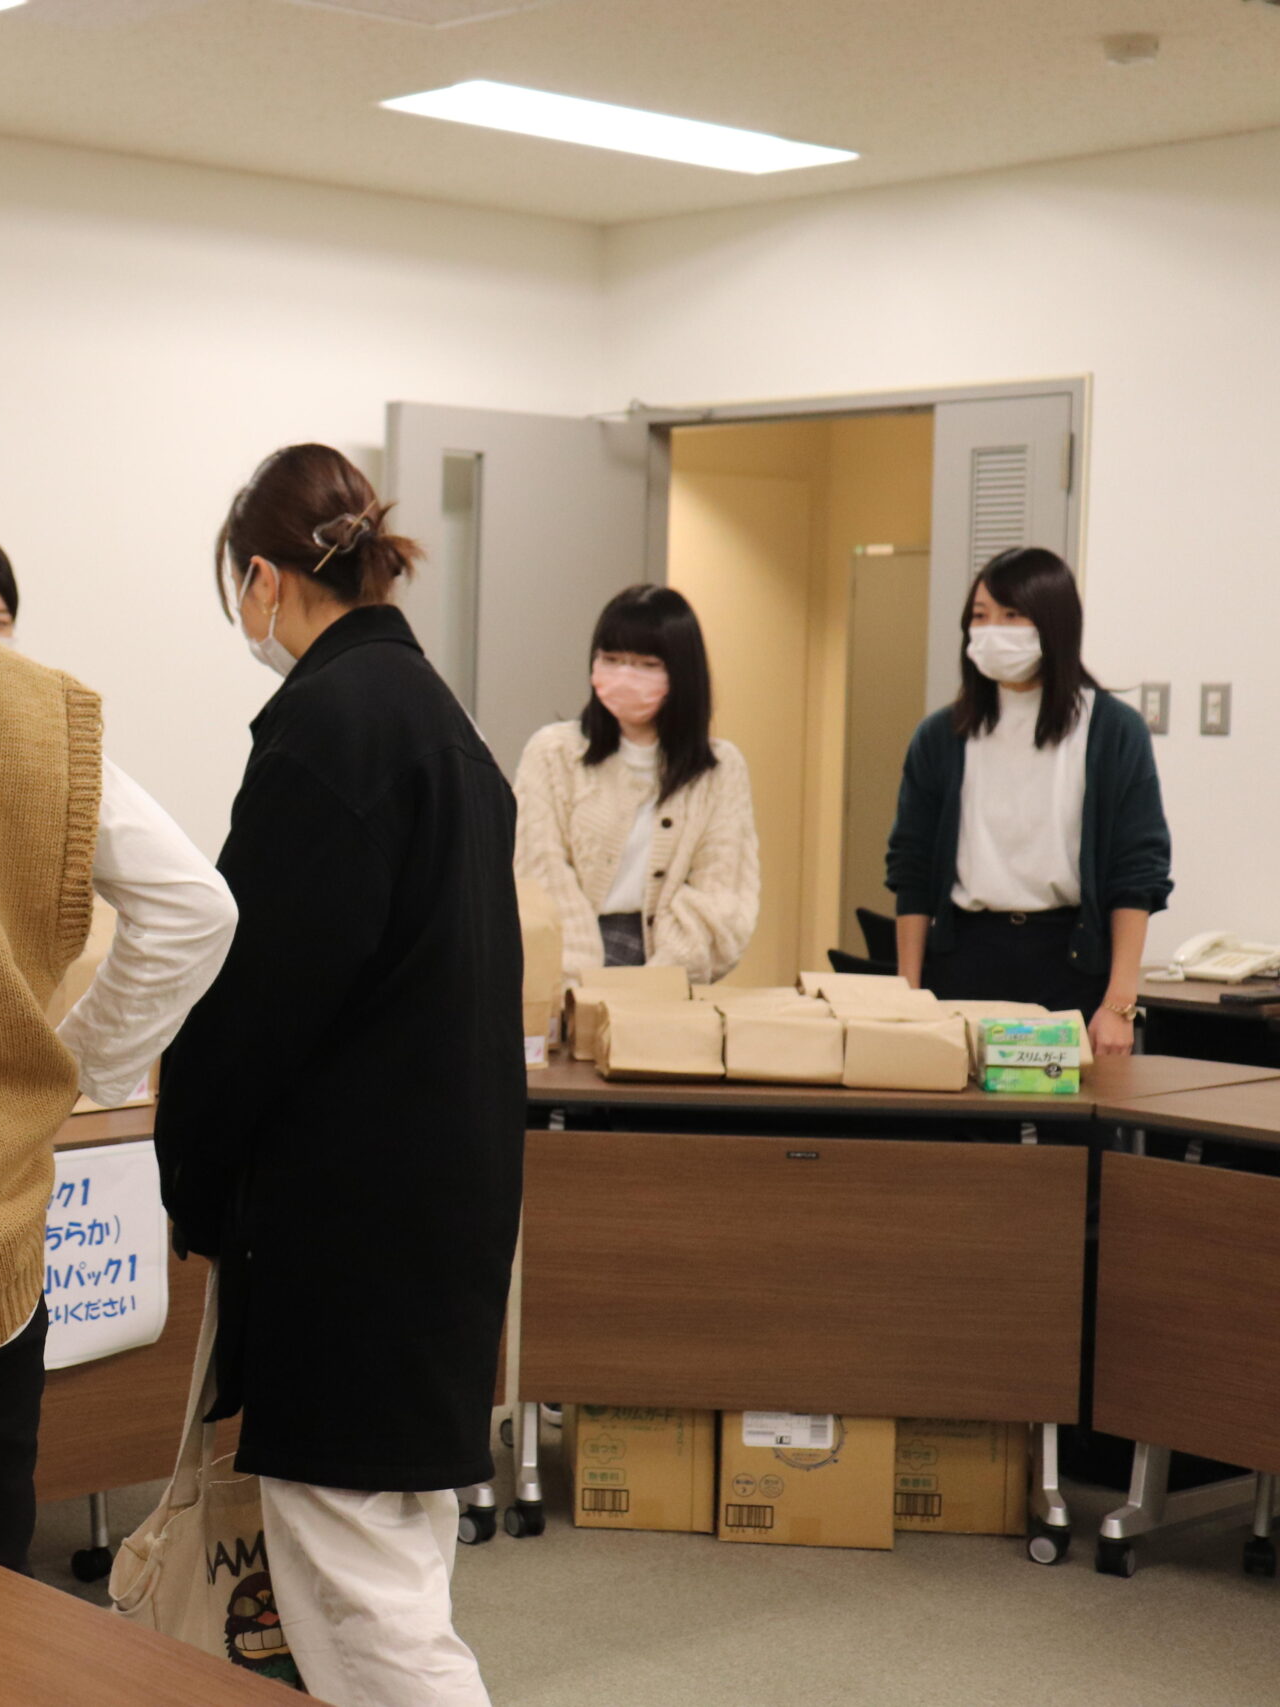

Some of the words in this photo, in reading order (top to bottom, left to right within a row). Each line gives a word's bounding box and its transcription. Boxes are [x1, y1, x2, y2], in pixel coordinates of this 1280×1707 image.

[1017, 1049, 1067, 1063] スリムガード
[48, 1295, 136, 1326] りください
